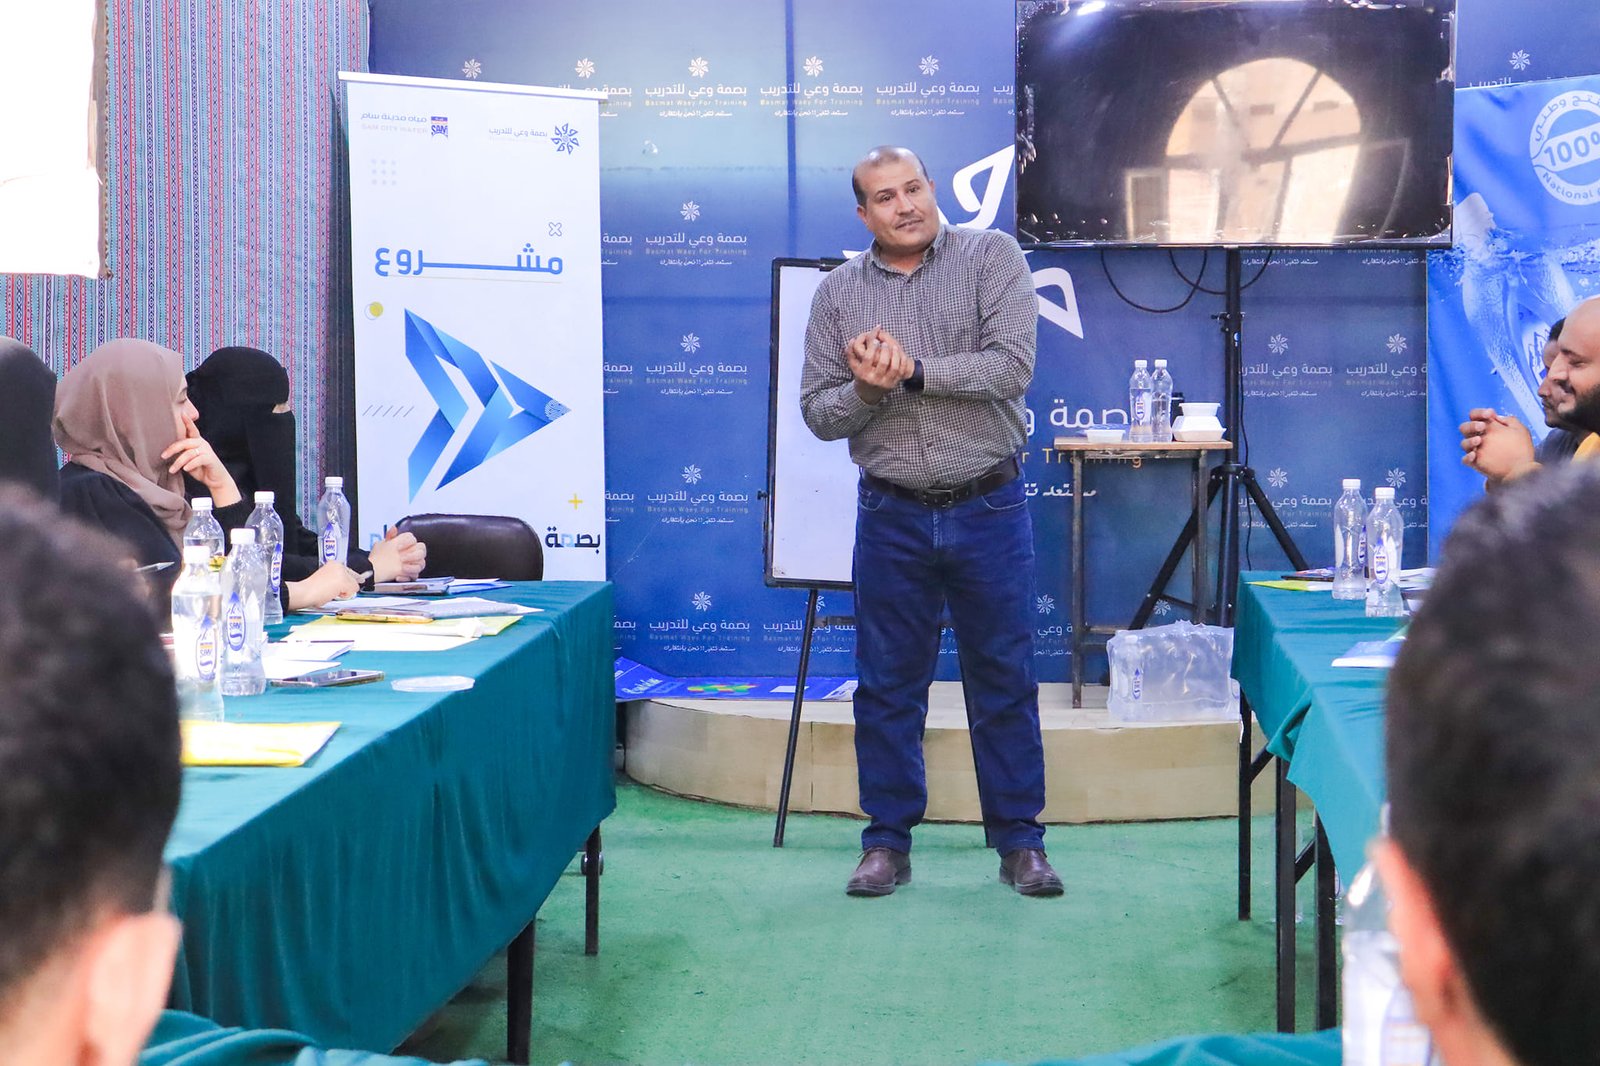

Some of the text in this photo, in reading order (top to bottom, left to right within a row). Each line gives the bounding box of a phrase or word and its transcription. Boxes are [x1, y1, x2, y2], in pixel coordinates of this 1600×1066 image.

[645, 83, 747, 99] بصمة وعي للتدريب
[760, 82, 863, 98] بصمة وعي للتدريب
[876, 82, 917, 95] للتدريب
[920, 84, 946, 97] وعي
[949, 82, 980, 94] بصمة
[1543, 172, 1594, 199] National
[602, 233, 633, 245] بصمة
[645, 232, 747, 248] بصمة وعي للتدريب
[603, 362, 633, 374] بصمة
[646, 362, 747, 378] بصمة وعي للتدريب
[1272, 366, 1297, 379] وعي
[1302, 363, 1333, 376] بصمة
[1346, 362, 1388, 376] للتدريب
[1391, 366, 1417, 378] وعي
[1050, 398, 1131, 428] صمة
[605, 490, 634, 503] بصمة
[647, 490, 748, 506] بصمة وعي للتدريب
[1301, 495, 1331, 508] بصمة
[1272, 497, 1297, 510] وعي
[545, 526, 601, 554] بصمة
[649, 619, 750, 634] بصمة وعي للتدريب
[763, 619, 803, 632] للتدريب
[1037, 626, 1063, 639] وعي
